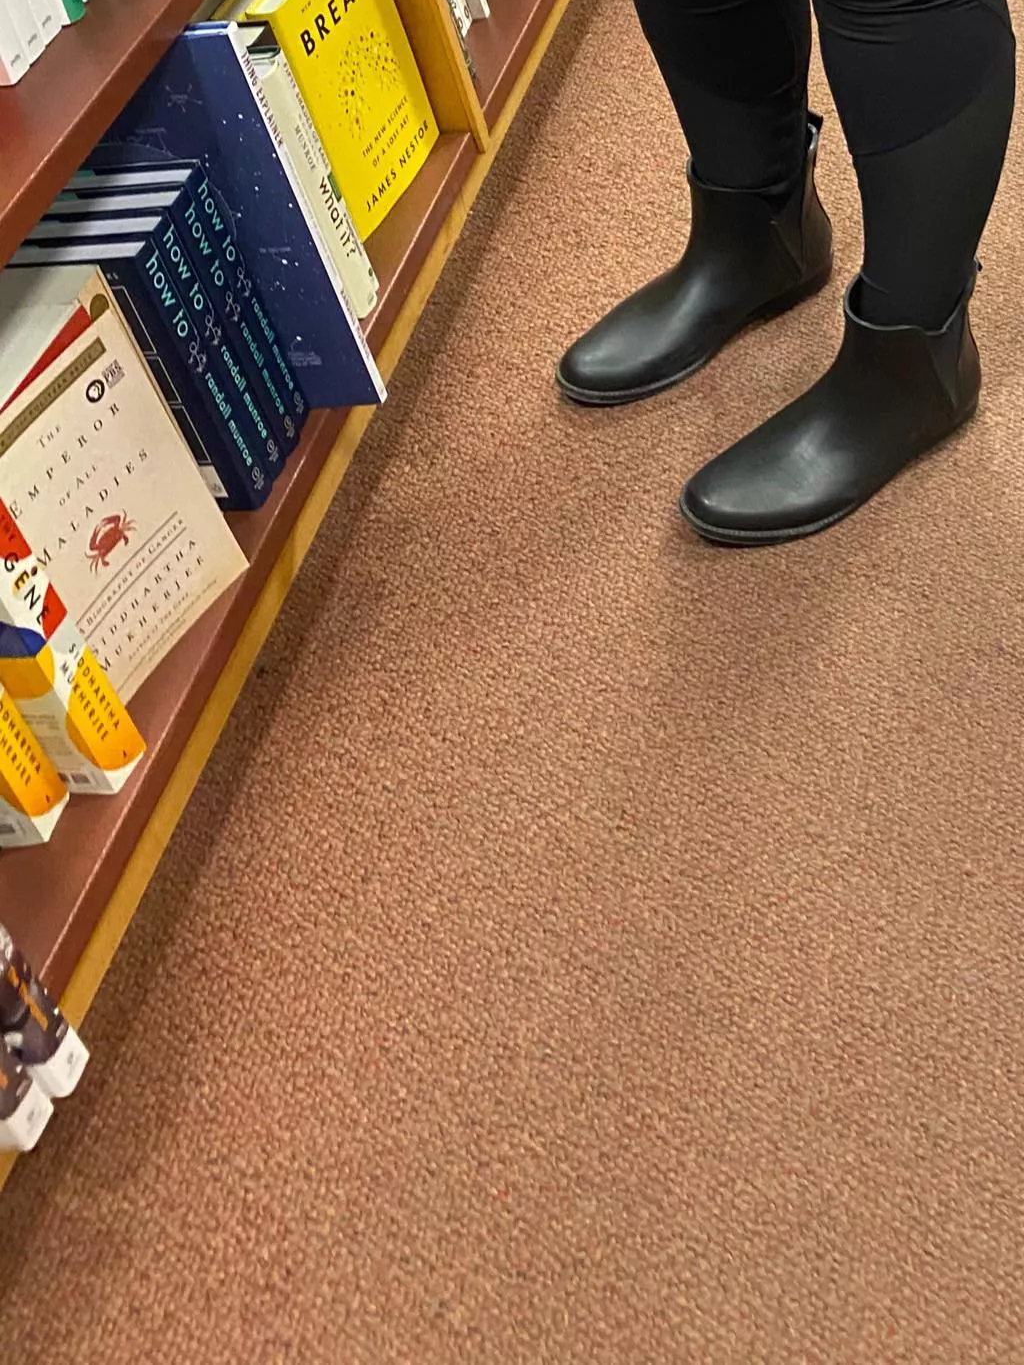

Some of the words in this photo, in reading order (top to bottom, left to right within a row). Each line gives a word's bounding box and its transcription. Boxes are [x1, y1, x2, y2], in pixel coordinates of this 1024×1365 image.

[241, 52, 258, 86] THING
[256, 88, 284, 148] EXPLAINER
[362, 144, 374, 158] THE
[374, 127, 386, 143] NEW
[386, 97, 408, 125] SCIENCE
[372, 157, 380, 167] OF
[387, 129, 400, 147] LOST
[399, 114, 409, 129] ART
[294, 125, 316, 171] MUNROE
[366, 170, 397, 212] JAMES
[398, 119, 428, 169] NESTOR
[184, 202, 210, 255] how
[210, 258, 225, 287] to
[197, 180, 224, 232] how
[222, 232, 236, 261] to
[319, 176, 346, 229] what
[339, 228, 355, 256] if?
[145, 250, 175, 307] how
[173, 309, 188, 338] to
[162, 224, 190, 280] how
[189, 282, 204, 310] to
[240, 321, 264, 369] randall
[262, 370, 285, 416] munroe
[251, 297, 276, 344] randall
[272, 344, 294, 391] munroe
[204, 372, 231, 423] randall
[228, 419, 252, 467] munroe
[220, 344, 246, 395] randall
[243, 393, 267, 439] munroe
[9, 403, 119, 520] EMPEROR
[36, 424, 62, 449] THE
[36, 448, 148, 568] MALADIES
[59, 491, 72, 506] OF
[75, 465, 97, 488] ALL
[4, 551, 49, 625] GENE
[86, 571, 134, 625] BIOGRAPHY
[136, 558, 146, 568] OF
[148, 519, 183, 554] CANCER
[91, 539, 196, 656] SIDDHARTHA
[99, 555, 204, 672] MUKHERJEE
[59, 662, 108, 741] MUKHERJEE
[67, 642, 120, 730] SIDDHARTHA
